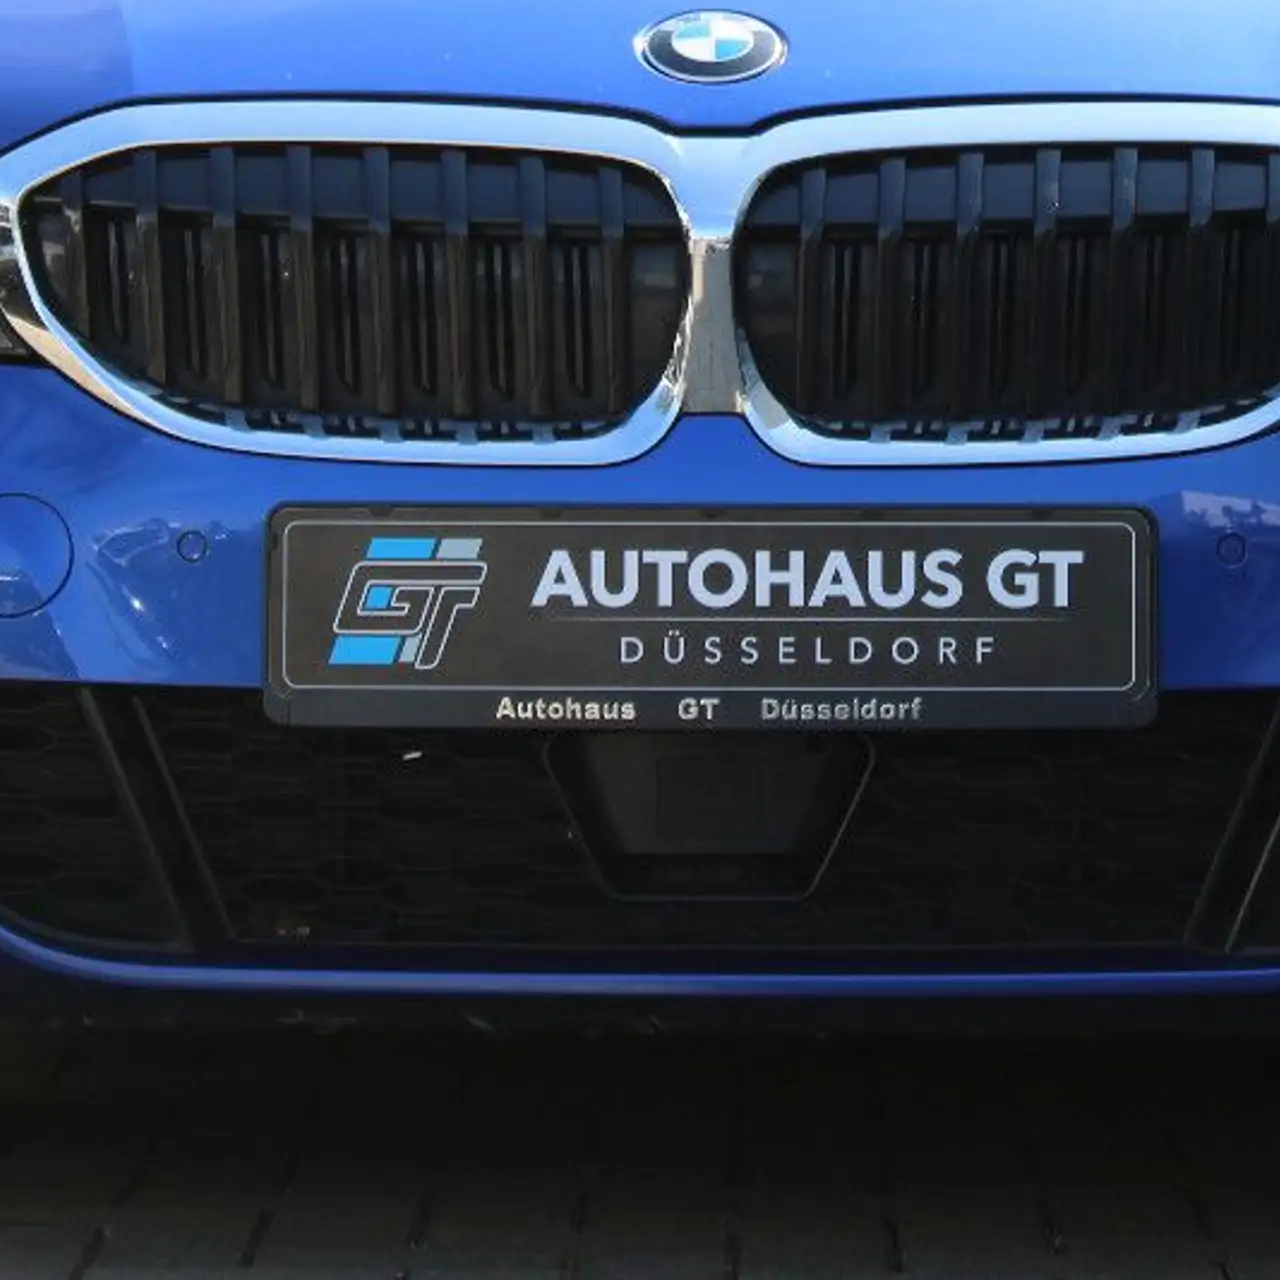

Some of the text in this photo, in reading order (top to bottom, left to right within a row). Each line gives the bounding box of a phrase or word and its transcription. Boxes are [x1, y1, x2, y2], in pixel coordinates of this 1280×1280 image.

[529, 548, 1085, 609] AUTOHAUS GT
[619, 628, 995, 665] DÜSSELDORF
[495, 695, 923, 721] Autohaus GT Düsseldorf
